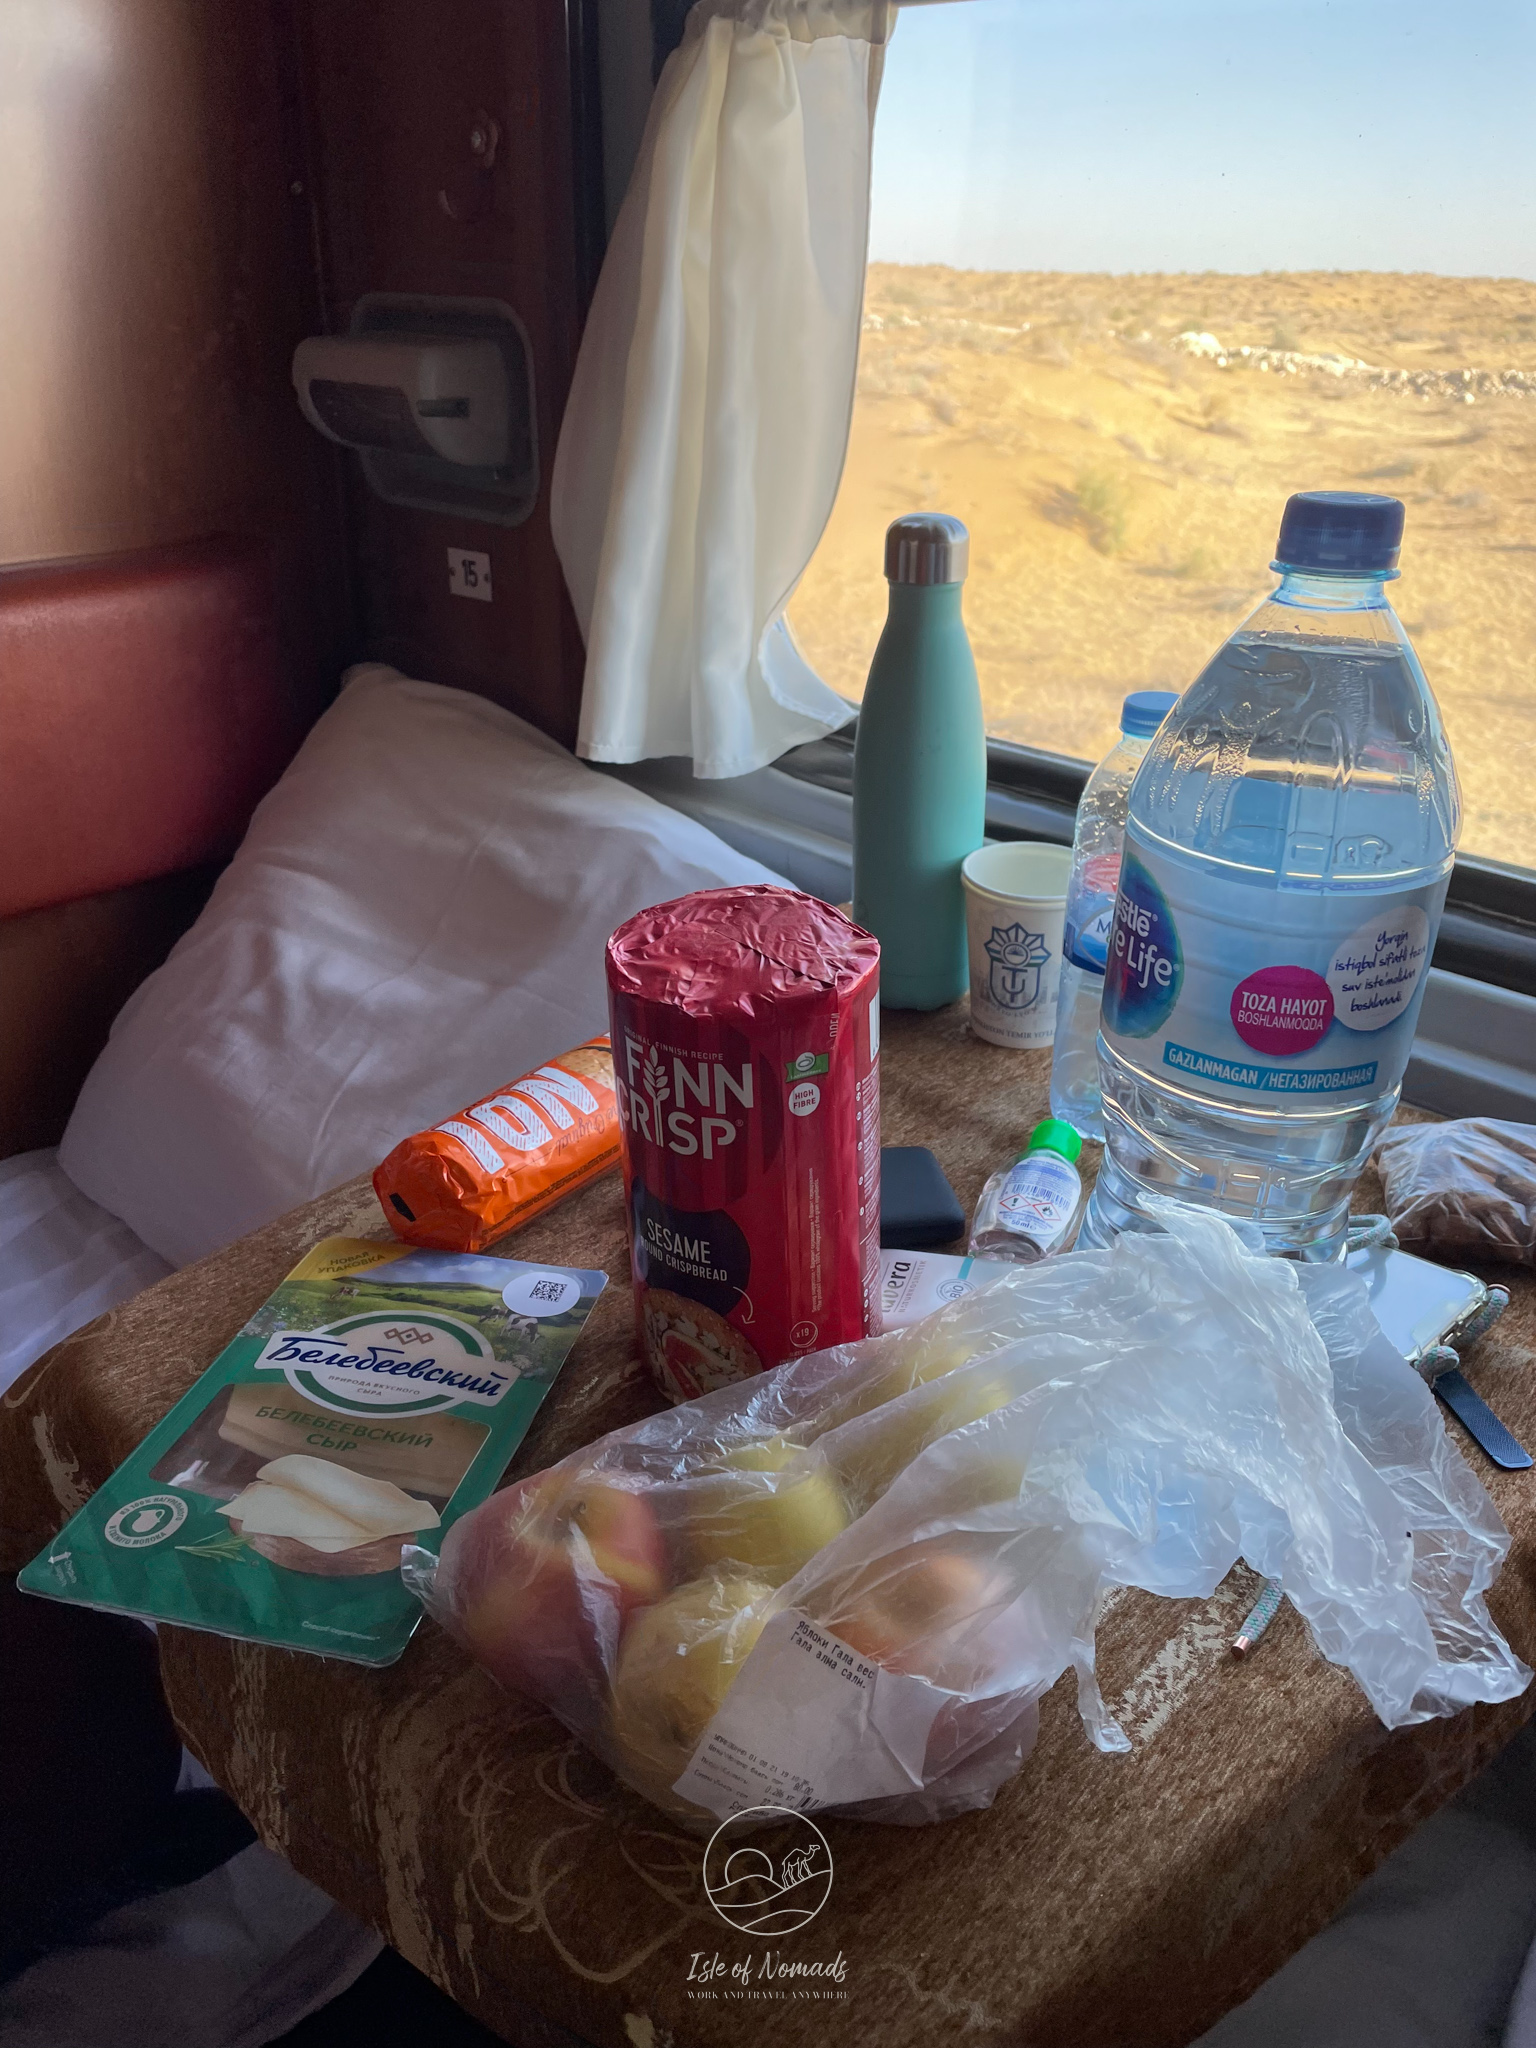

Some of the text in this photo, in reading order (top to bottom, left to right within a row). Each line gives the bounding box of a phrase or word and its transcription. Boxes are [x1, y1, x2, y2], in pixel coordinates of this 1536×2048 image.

[462, 559, 479, 587] 15
[1127, 935, 1173, 989] Life
[1335, 952, 1378, 977] istiqbol
[1242, 991, 1328, 1015] TOZA HAYOT
[1237, 1011, 1324, 1031] BOSHLANMOQDA
[1006, 1029, 1032, 1039] TEMIR
[655, 1042, 688, 1057] FINNISH
[691, 1051, 724, 1061] RECIPE
[1168, 1047, 1258, 1085] GAZLANMAGAN
[793, 1097, 816, 1109] FIBRE
[795, 1089, 814, 1100] HIGH
[557, 1112, 605, 1156] Original
[646, 1217, 712, 1265] SESAME
[317, 1254, 386, 1274] УПАКОВКА
[330, 1251, 370, 1266] НОВАЯ
[665, 1254, 728, 1282] CRISPBREAD
[950, 1284, 964, 1299] BIO
[266, 1336, 509, 1398] Белебеевский
[328, 1375, 421, 1396] ПРИРОДА ВКУСНОГО
[356, 1387, 383, 1397] СЫРА
[255, 1404, 435, 1449] БЕЛЕБЕЕВСКИЙ
[305, 1433, 359, 1453] СЫР
[132, 1531, 167, 1546] МОЛОКА
[790, 1631, 812, 1652] Гала
[796, 1620, 875, 1679] Яблоки Гала вес
